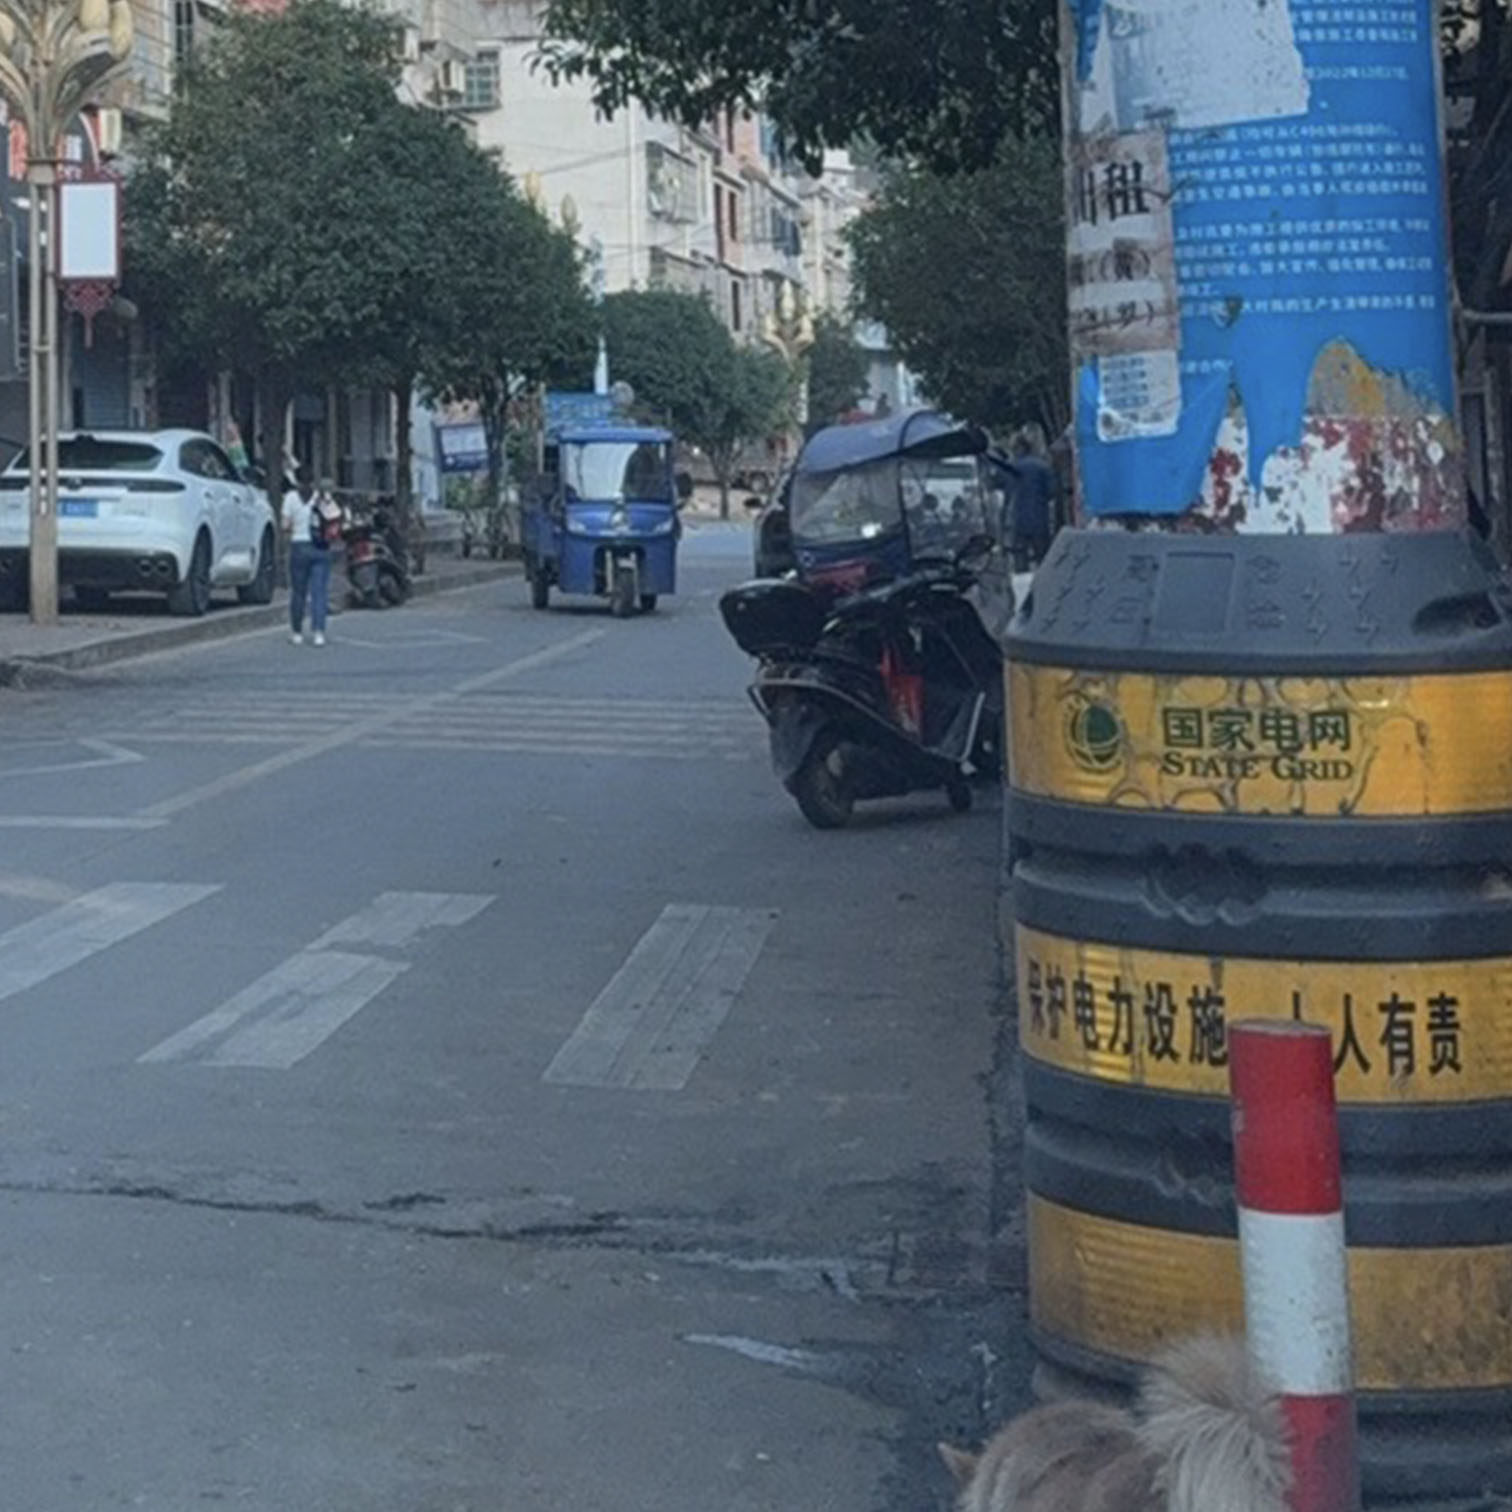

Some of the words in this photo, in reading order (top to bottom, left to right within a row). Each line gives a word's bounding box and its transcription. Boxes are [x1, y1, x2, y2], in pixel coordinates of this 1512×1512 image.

[1163, 707, 1352, 752] 国家电网
[1161, 750, 1260, 780] STATE
[1272, 755, 1353, 781] GRID
[1028, 958, 1228, 1067] 保护电力设施
